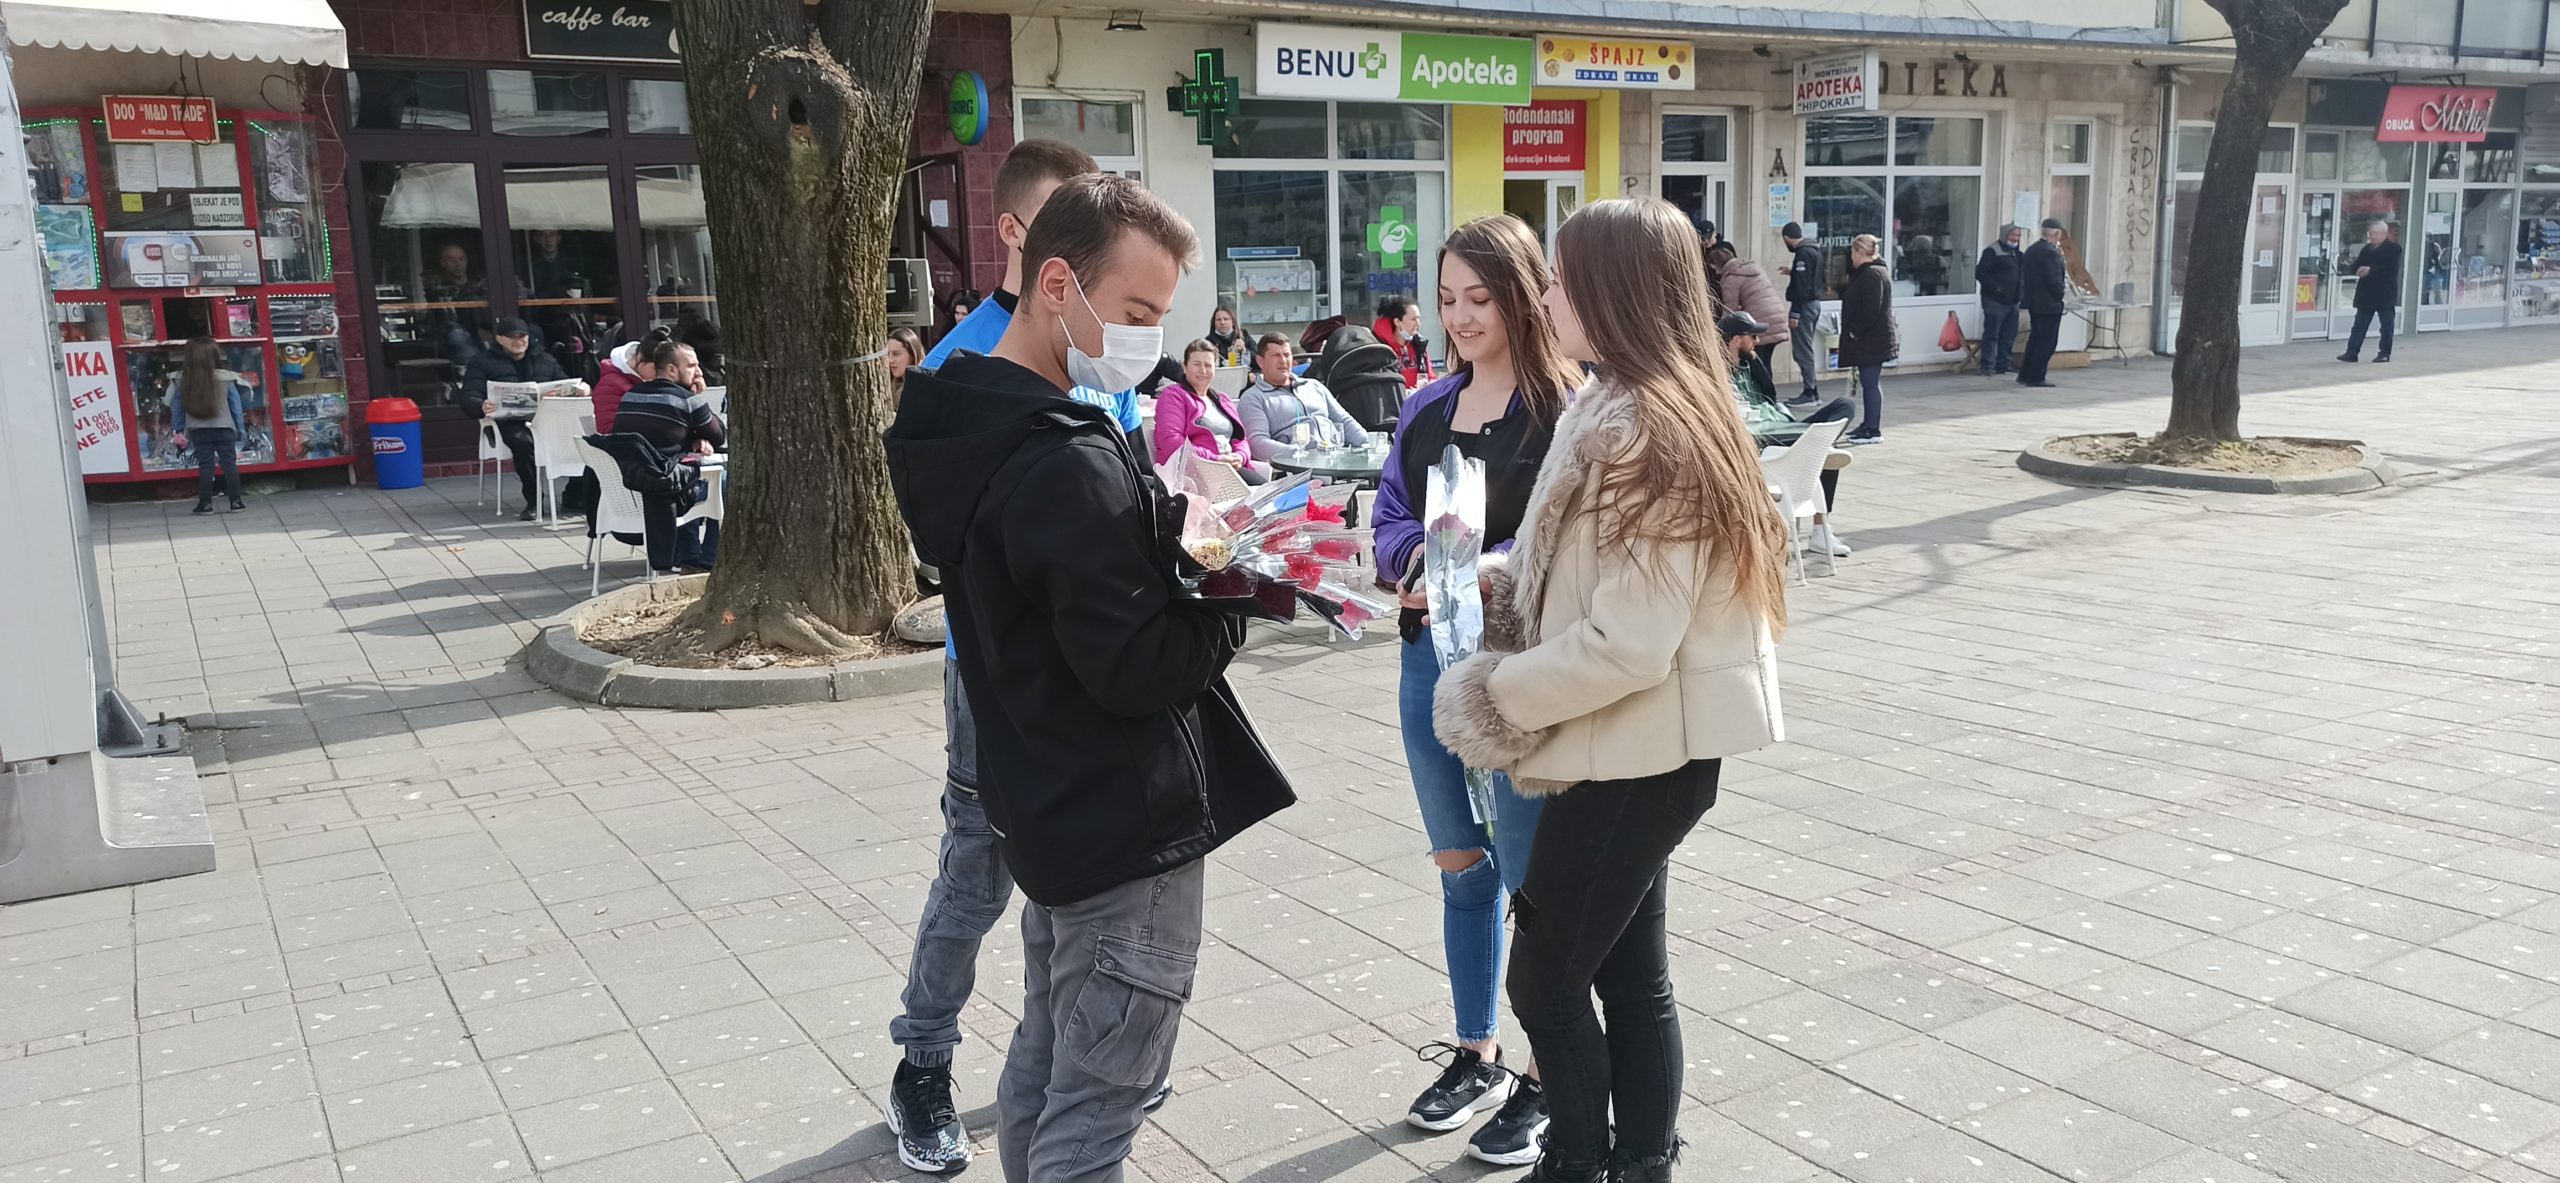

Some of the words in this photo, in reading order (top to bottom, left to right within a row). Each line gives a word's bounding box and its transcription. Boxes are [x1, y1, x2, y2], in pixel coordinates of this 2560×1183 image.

[542, 6, 603, 31] caffe
[612, 6, 651, 28] bar
[1276, 47, 1355, 78] BENU
[1590, 42, 1645, 66] ŠPAJZ
[1411, 54, 1518, 88] Apoteka
[1577, 70, 1617, 80] ZDRAVA
[1625, 72, 1658, 81] HRANA
[1797, 75, 1862, 101] APOTEKA
[113, 103, 135, 121] DOO
[1797, 95, 1862, 112] "HIPOKRAT"
[2385, 117, 2415, 131] OBUĆA
[1512, 128, 1564, 146] program
[1505, 154, 1544, 166] dekoracije
[1549, 154, 1571, 164] baloni
[193, 197, 218, 206] OBJEKAT
[220, 197, 227, 206] JE
[228, 197, 240, 206] POD
[1367, 273, 1418, 290] BENU
[65, 351, 109, 377] IKA
[91, 409, 111, 424] 067
[96, 416, 116, 430] 068
[100, 423, 120, 437] 069
